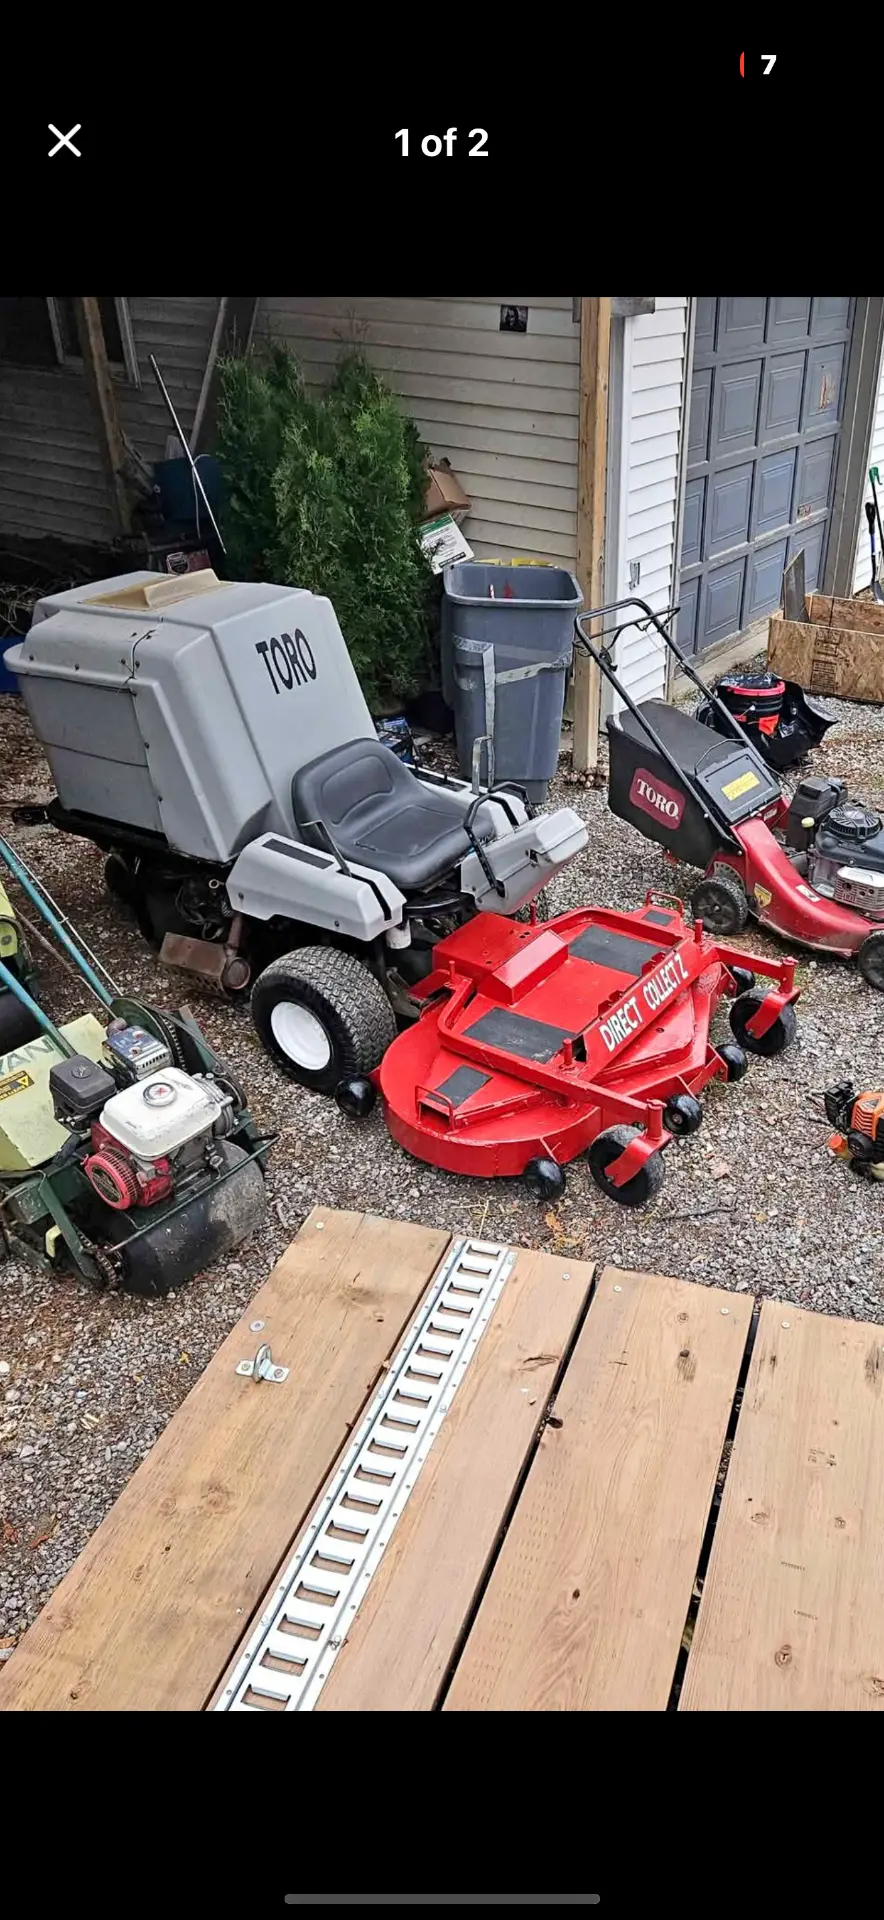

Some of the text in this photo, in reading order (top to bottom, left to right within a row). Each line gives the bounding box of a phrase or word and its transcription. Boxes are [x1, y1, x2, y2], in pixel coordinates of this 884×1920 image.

[255, 628, 317, 695] TORO
[637, 778, 679, 818] TORO
[599, 953, 689, 1053] DIRECT COLLECT Z
